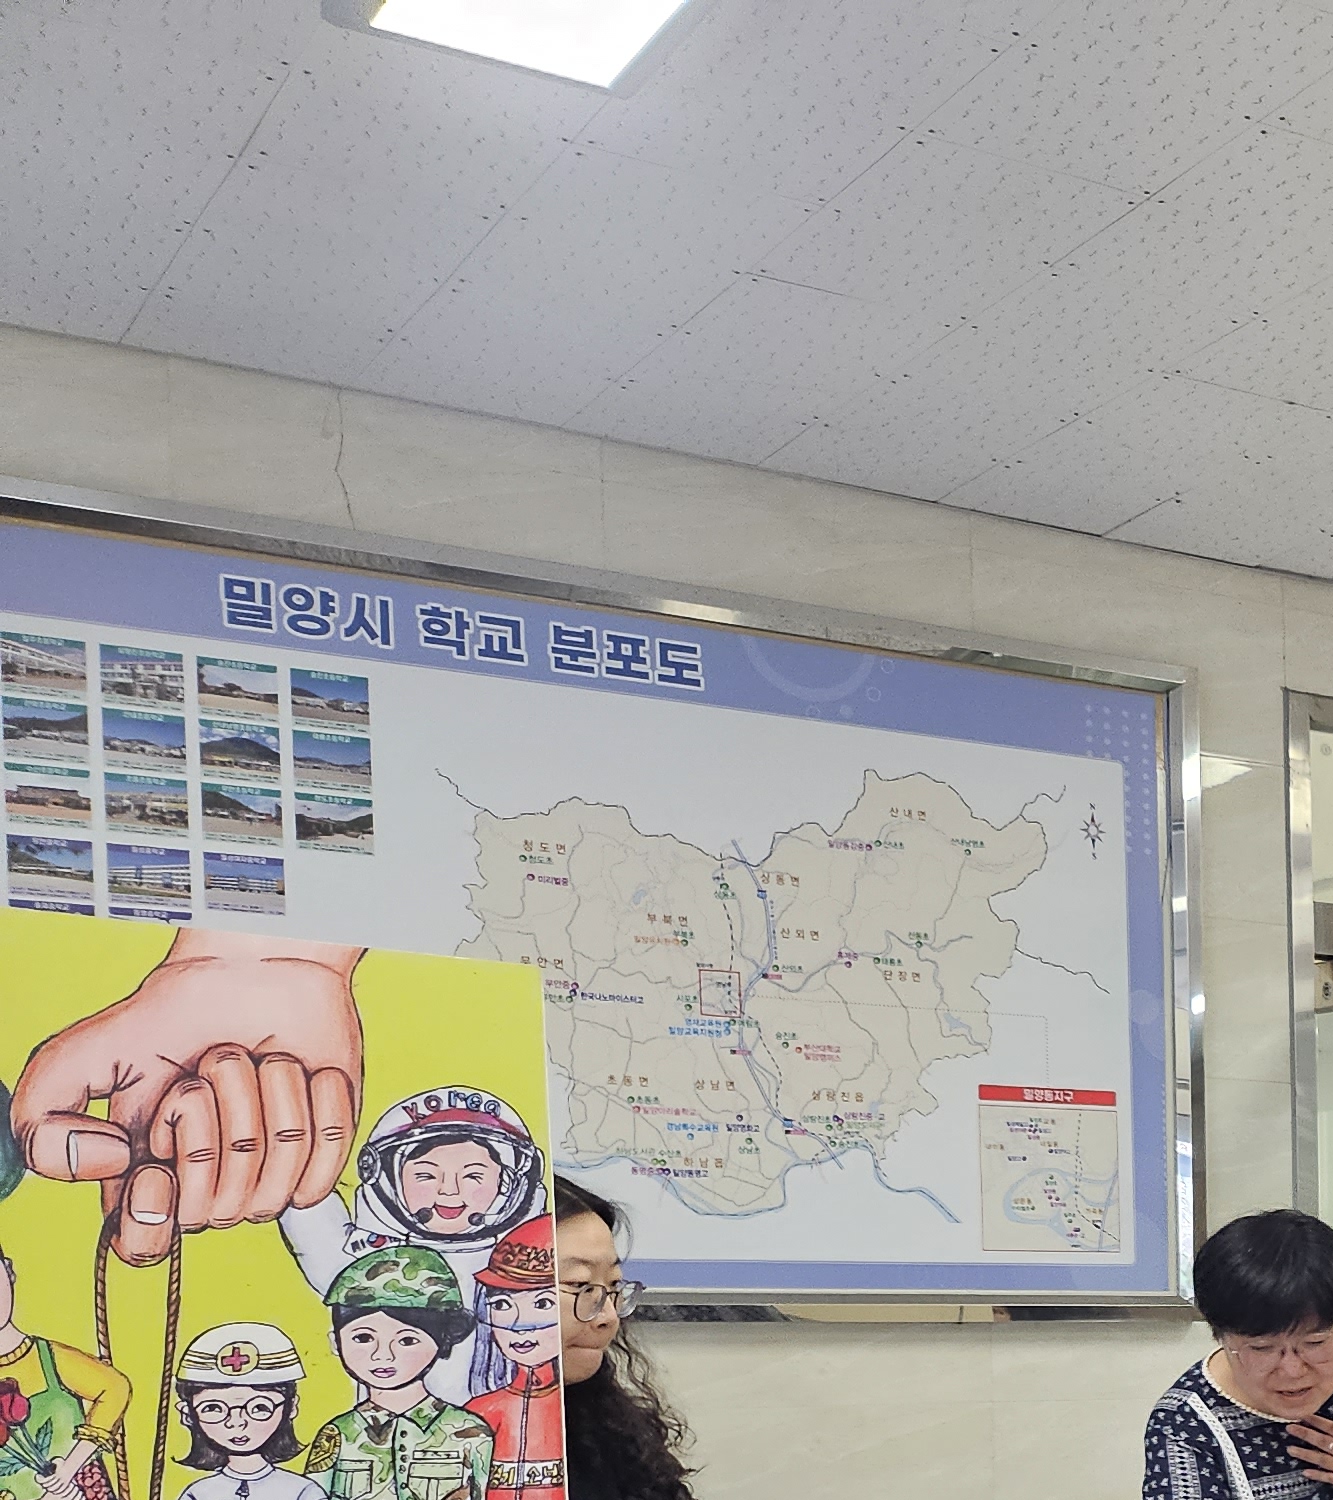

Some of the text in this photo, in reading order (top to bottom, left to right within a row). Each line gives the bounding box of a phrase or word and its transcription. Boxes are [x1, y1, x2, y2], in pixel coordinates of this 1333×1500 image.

[219, 573, 705, 692] 밀양시 학교 분포도
[889, 807, 927, 821] 산내면
[523, 839, 567, 855] 청도면
[760, 873, 800, 887] 상동면
[646, 913, 688, 927] 부북면
[780, 928, 820, 941] 산외면
[883, 969, 921, 983] 단장면
[607, 1075, 649, 1087] 초동면
[695, 1080, 736, 1092] 상남면
